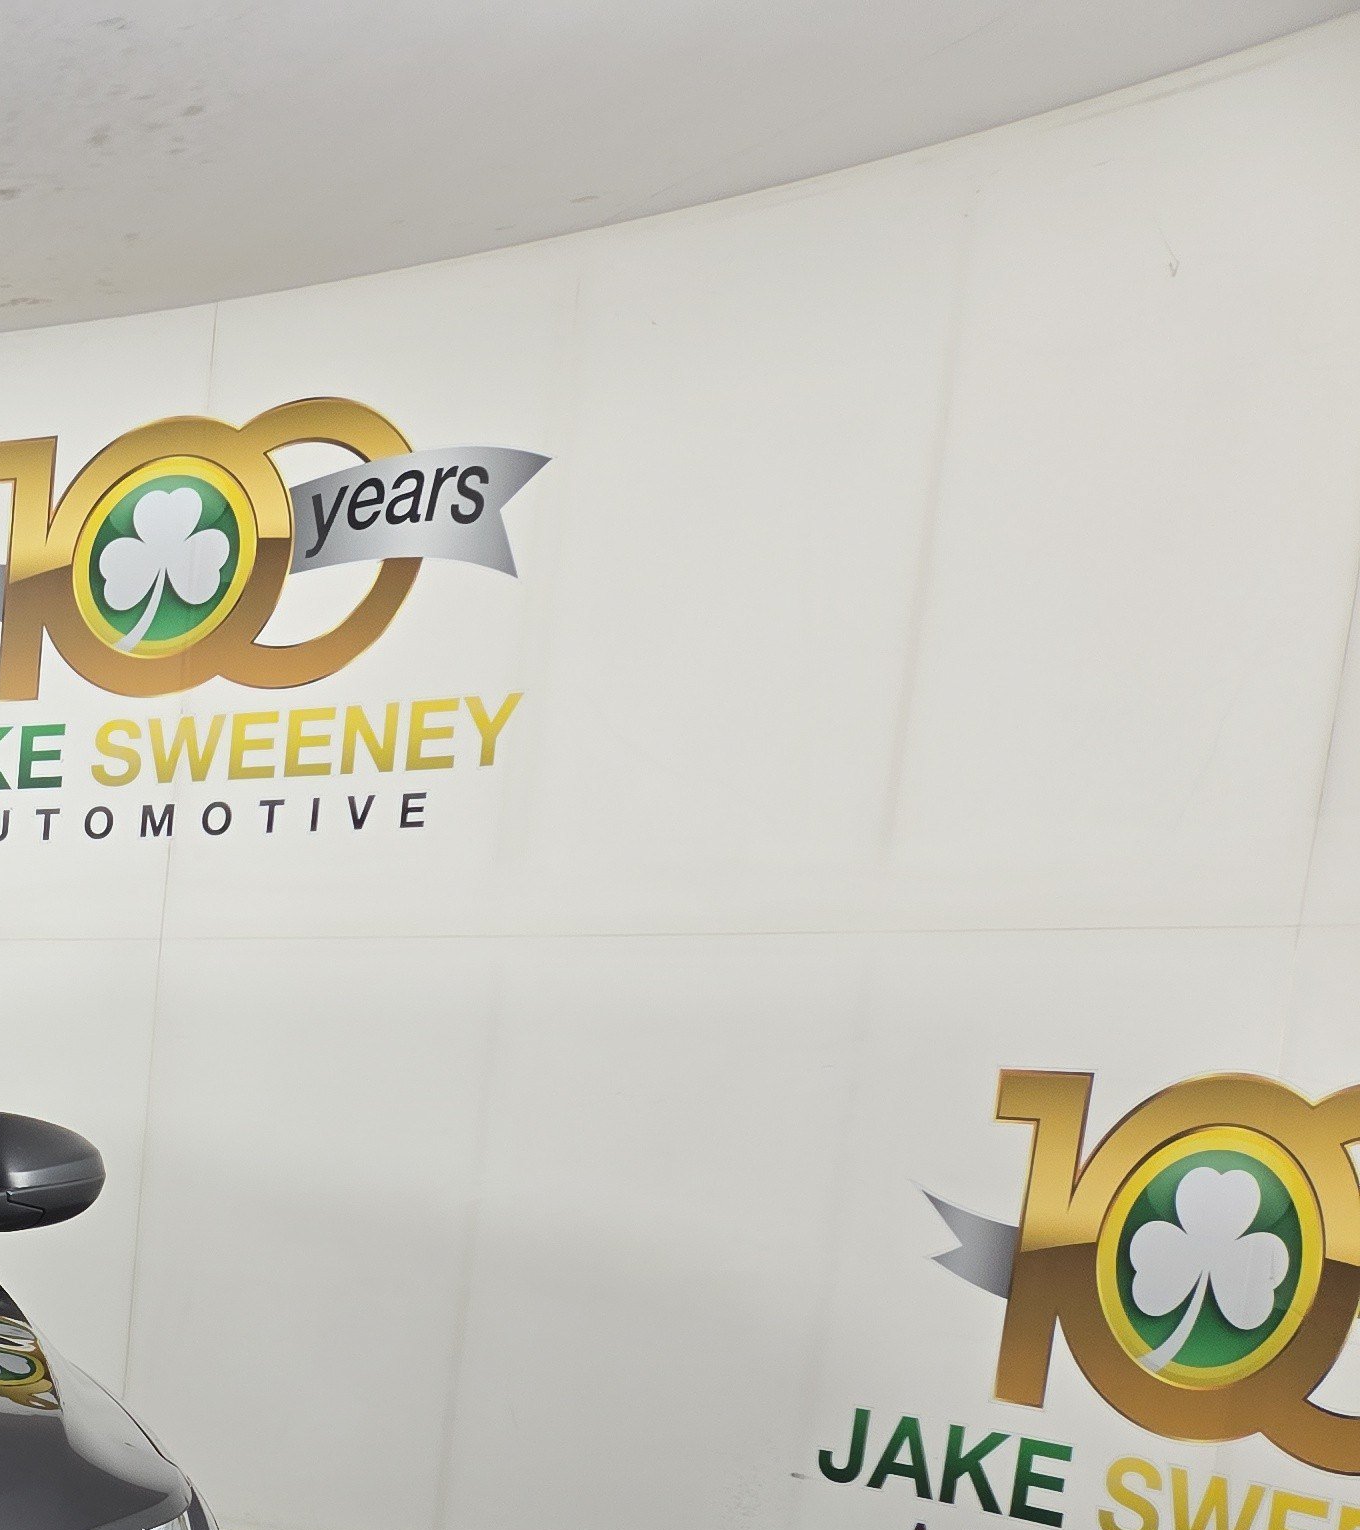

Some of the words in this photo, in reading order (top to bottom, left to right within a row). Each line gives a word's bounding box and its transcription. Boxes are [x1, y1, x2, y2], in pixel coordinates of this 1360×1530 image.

[305, 463, 489, 558] years
[91, 692, 523, 787] SWEENEY
[818, 1408, 1073, 1529] JAKE
